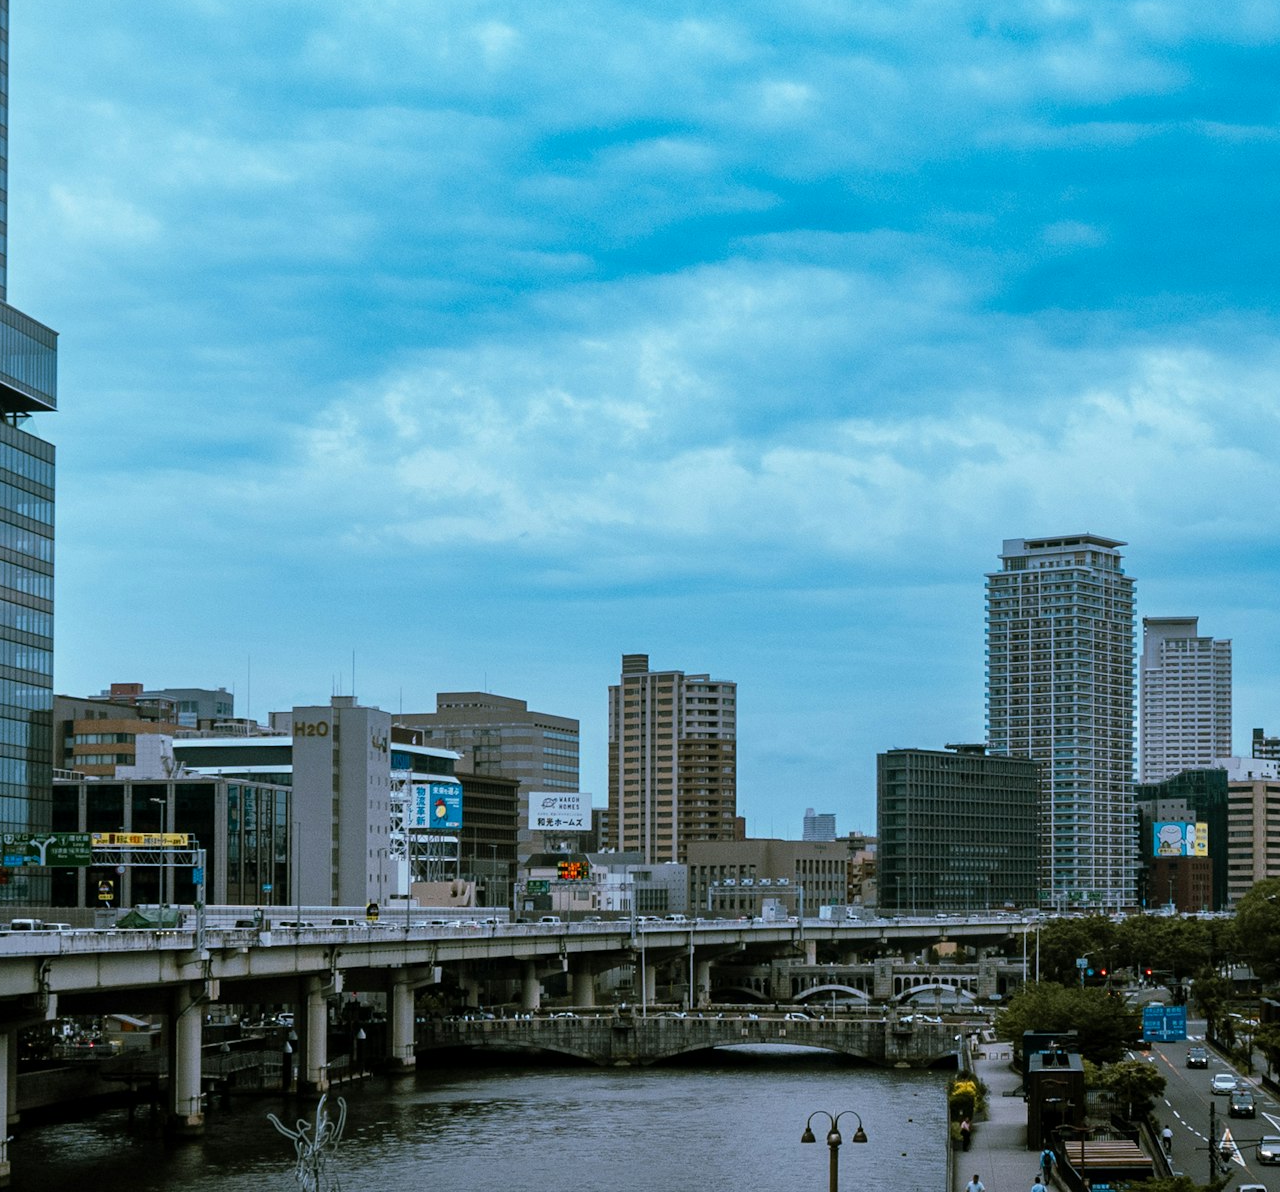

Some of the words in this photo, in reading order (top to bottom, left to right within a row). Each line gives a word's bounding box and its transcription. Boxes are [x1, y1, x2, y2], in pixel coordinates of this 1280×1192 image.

[294, 721, 329, 737] H2O
[416, 786, 426, 826] 物流革新
[537, 817, 583, 827] 和光ホームズ
